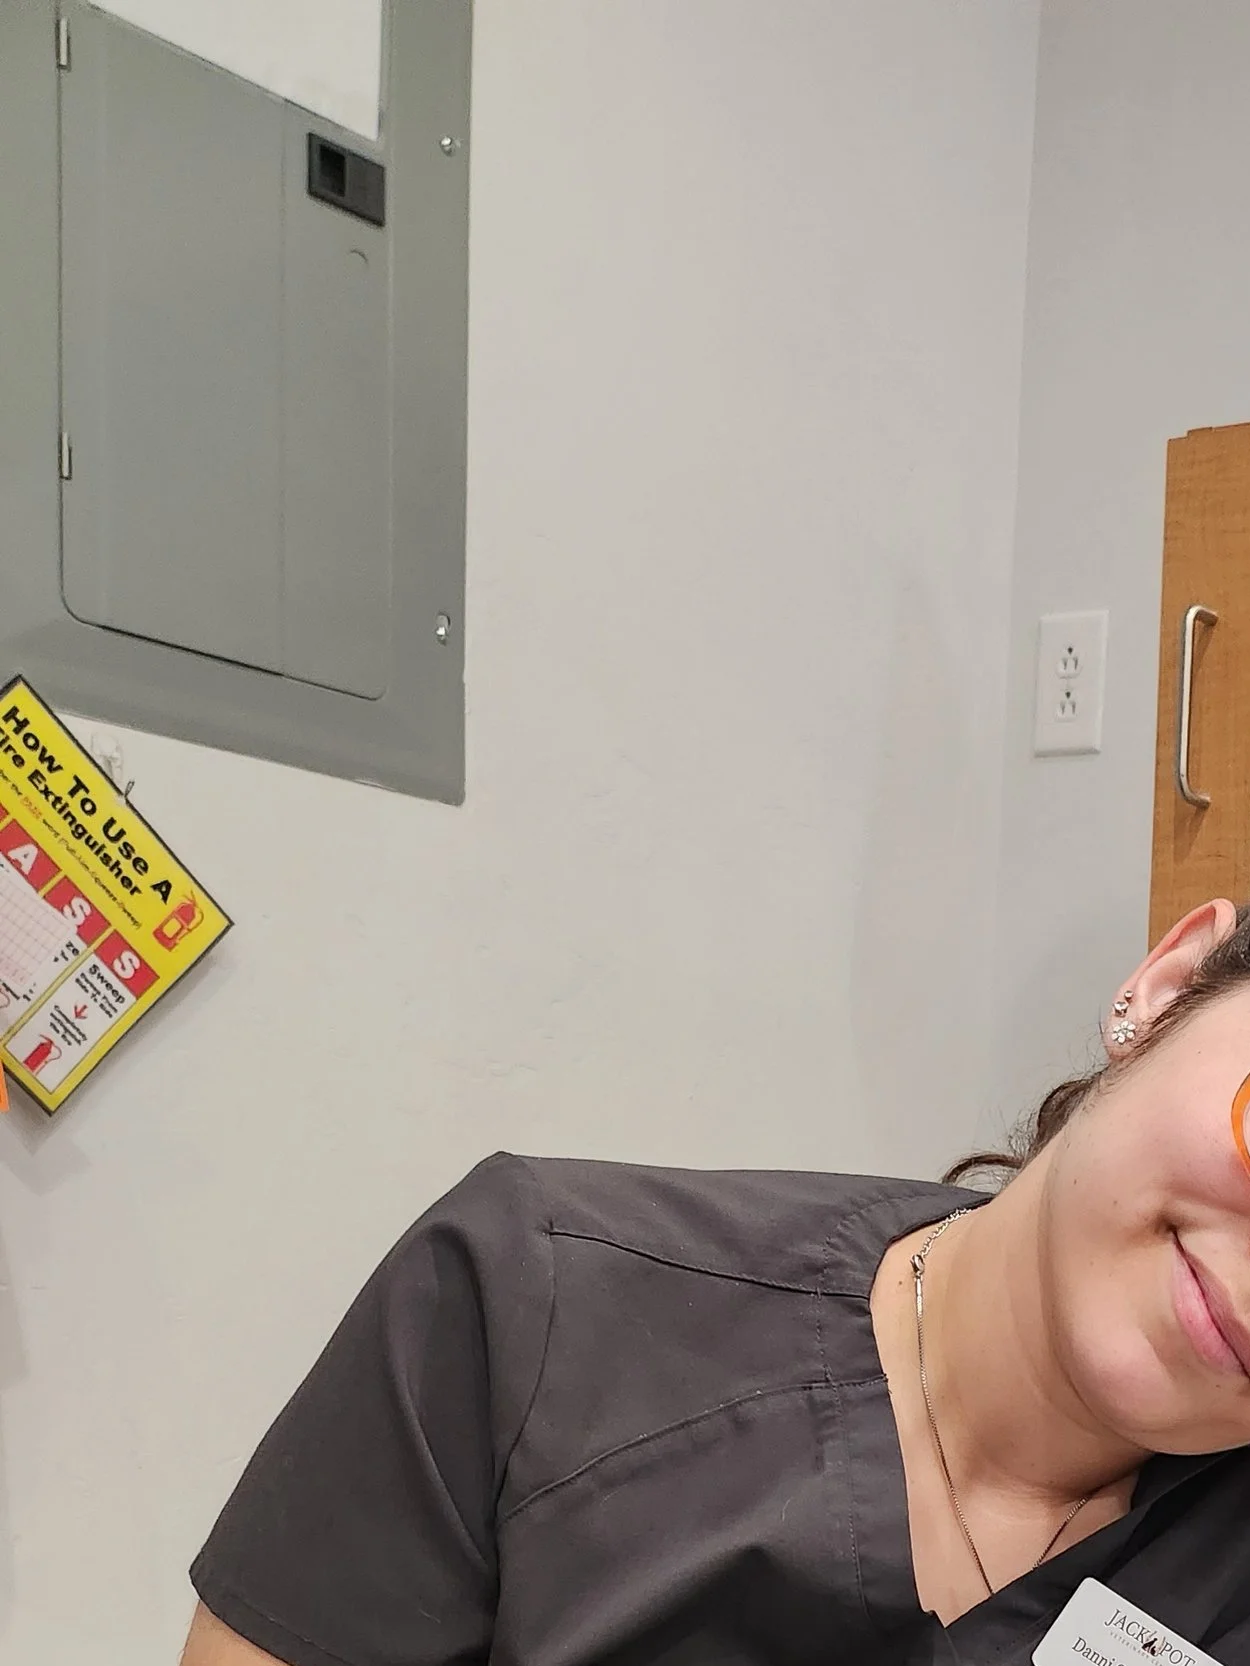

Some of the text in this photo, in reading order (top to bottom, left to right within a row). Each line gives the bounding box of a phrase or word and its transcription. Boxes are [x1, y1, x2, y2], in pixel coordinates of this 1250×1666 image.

[0, 728, 143, 895] ire Extinguisher
[2, 706, 172, 904] How To Use A
[8, 843, 38, 875] A
[62, 896, 92, 925] S
[112, 950, 140, 979] S
[89, 964, 125, 1003] Sweep
